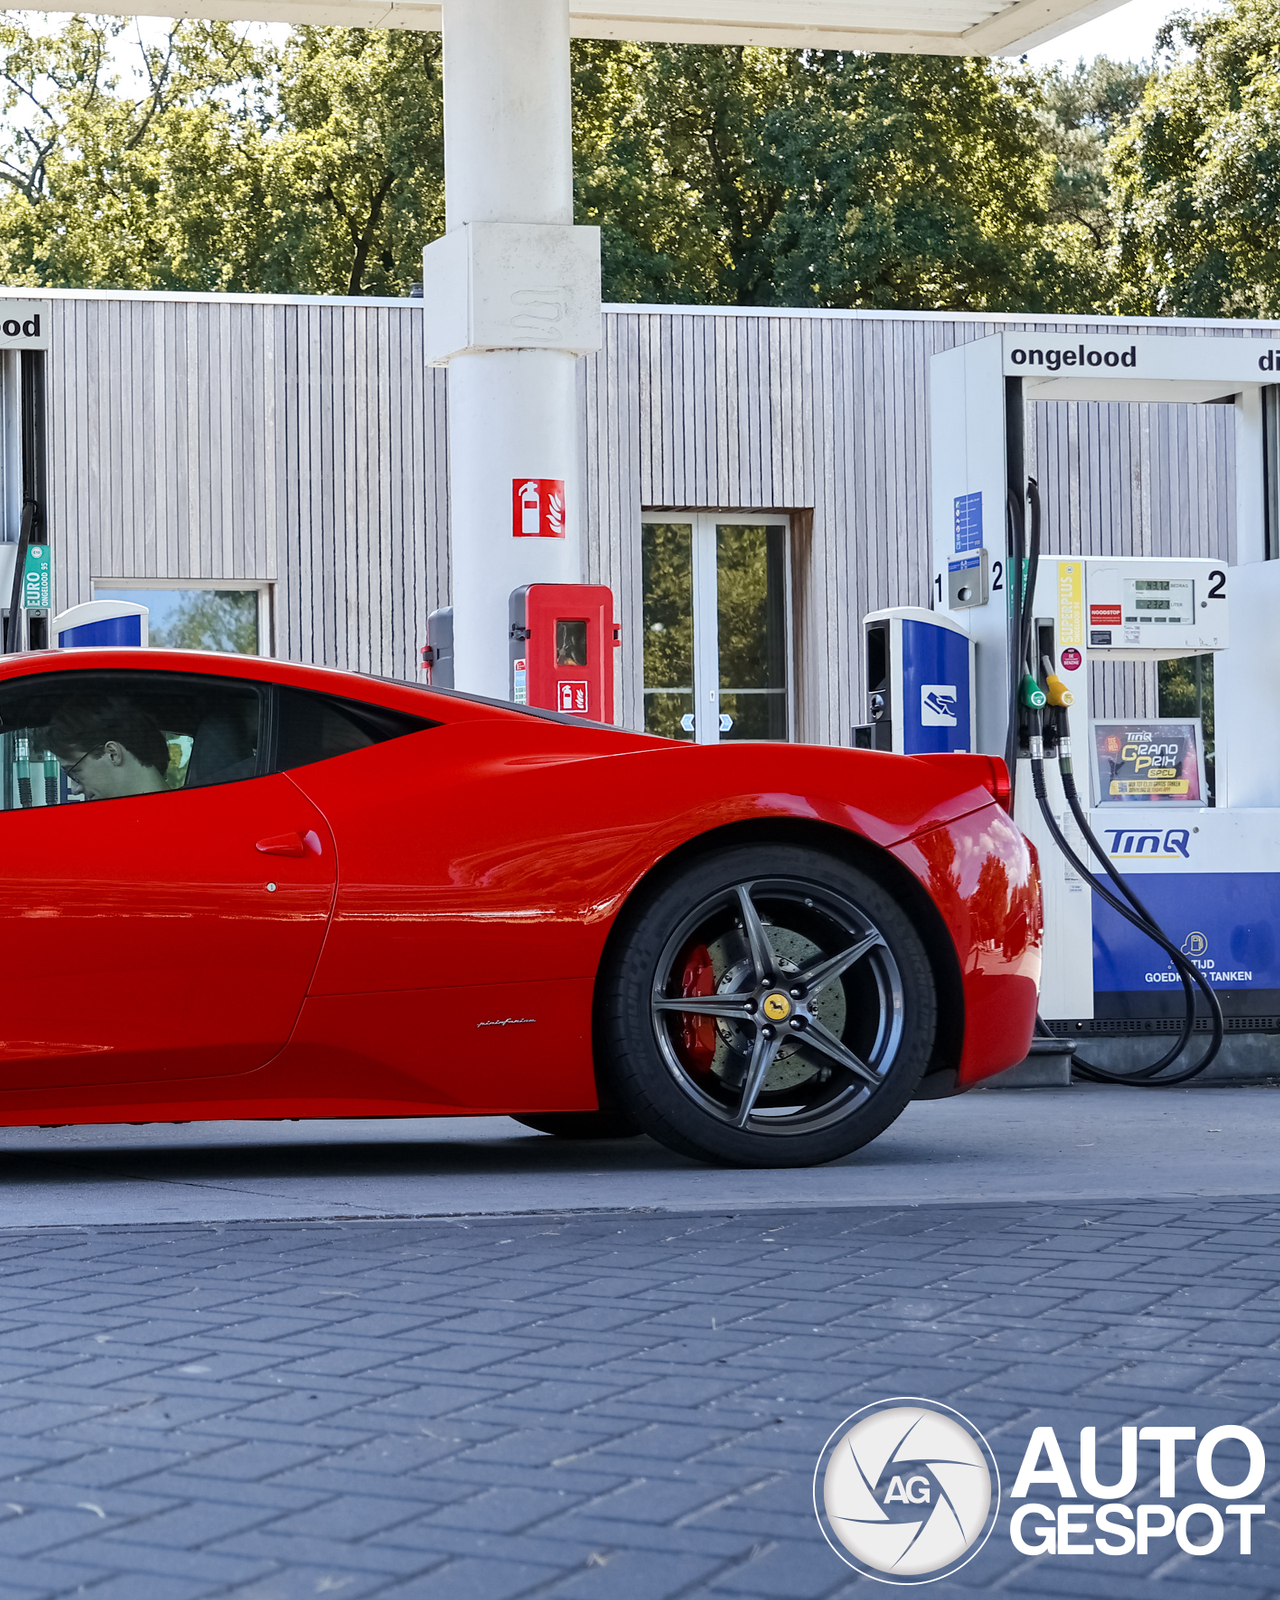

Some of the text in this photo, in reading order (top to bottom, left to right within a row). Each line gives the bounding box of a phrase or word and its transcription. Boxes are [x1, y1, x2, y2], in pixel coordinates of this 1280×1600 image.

[1010, 344, 1138, 371] ongelood
[27, 572, 40, 607] EURO
[41, 562, 49, 607] ONGELOOD 95
[934, 573, 943, 603] 1
[992, 560, 1004, 591] 2
[1207, 570, 1226, 599] 2
[1061, 576, 1074, 643] SUPERPLUS
[1121, 744, 1178, 761] GRAND
[1135, 756, 1176, 773] PRIX
[1149, 769, 1174, 777] SPEL
[1191, 959, 1215, 969] TIJD
[1209, 971, 1252, 981] TANKEN
